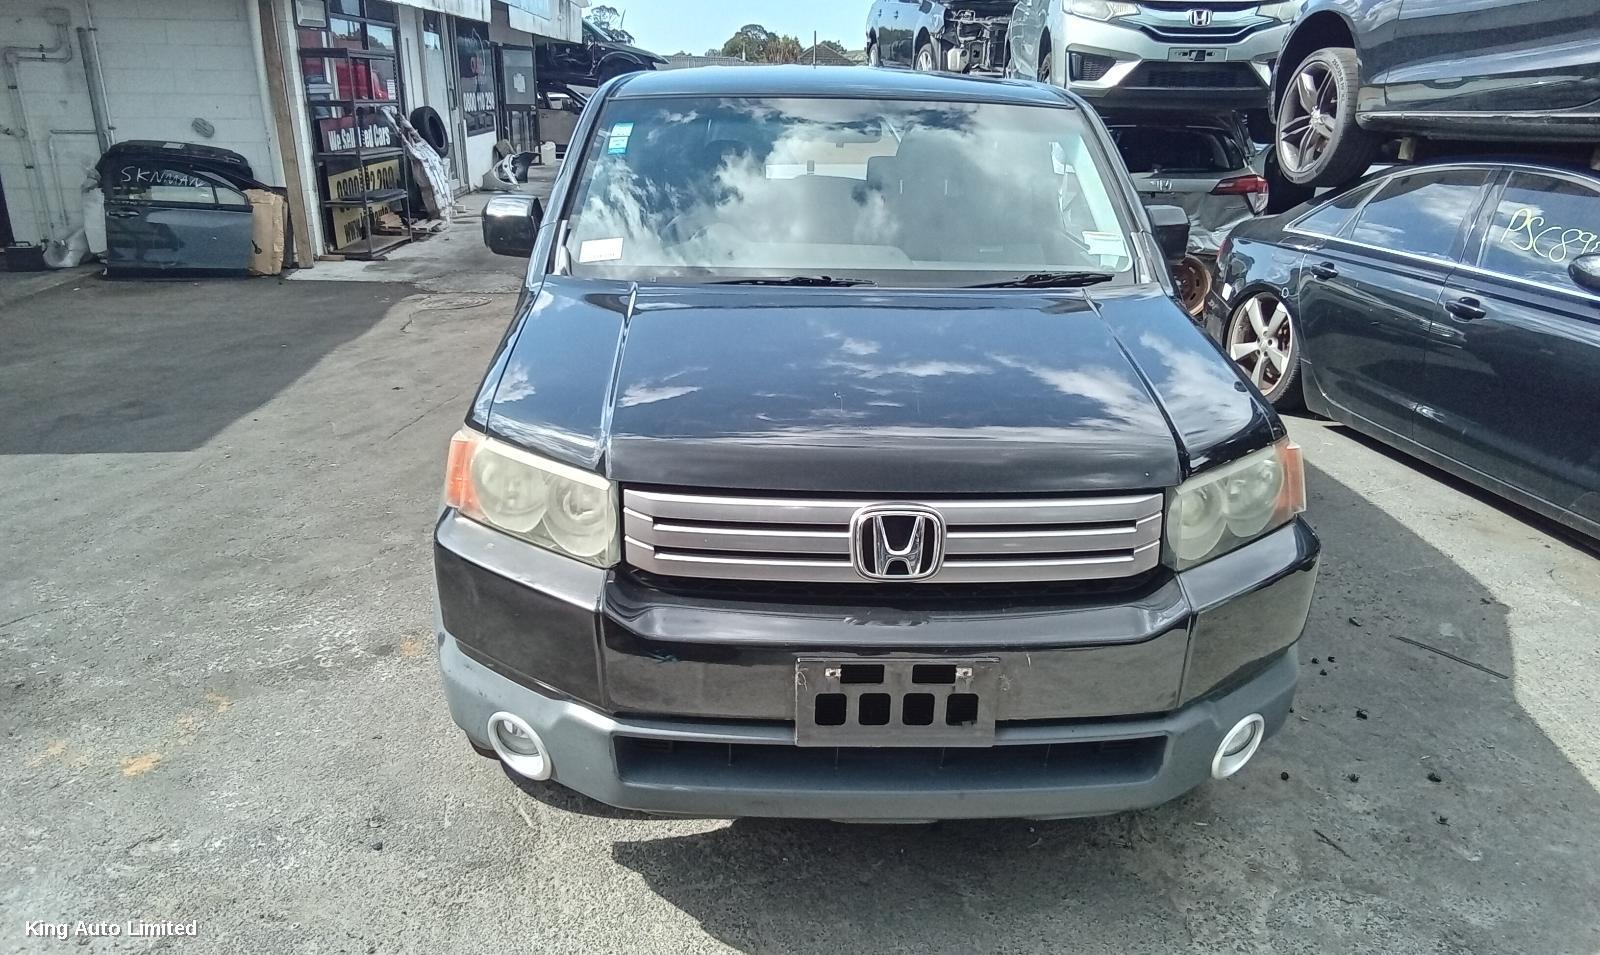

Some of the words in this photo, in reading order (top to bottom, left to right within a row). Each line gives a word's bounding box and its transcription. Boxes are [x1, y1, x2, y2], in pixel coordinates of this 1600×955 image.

[328, 130, 341, 151] We
[341, 128, 356, 149] Sell
[373, 123, 391, 147] Cars
